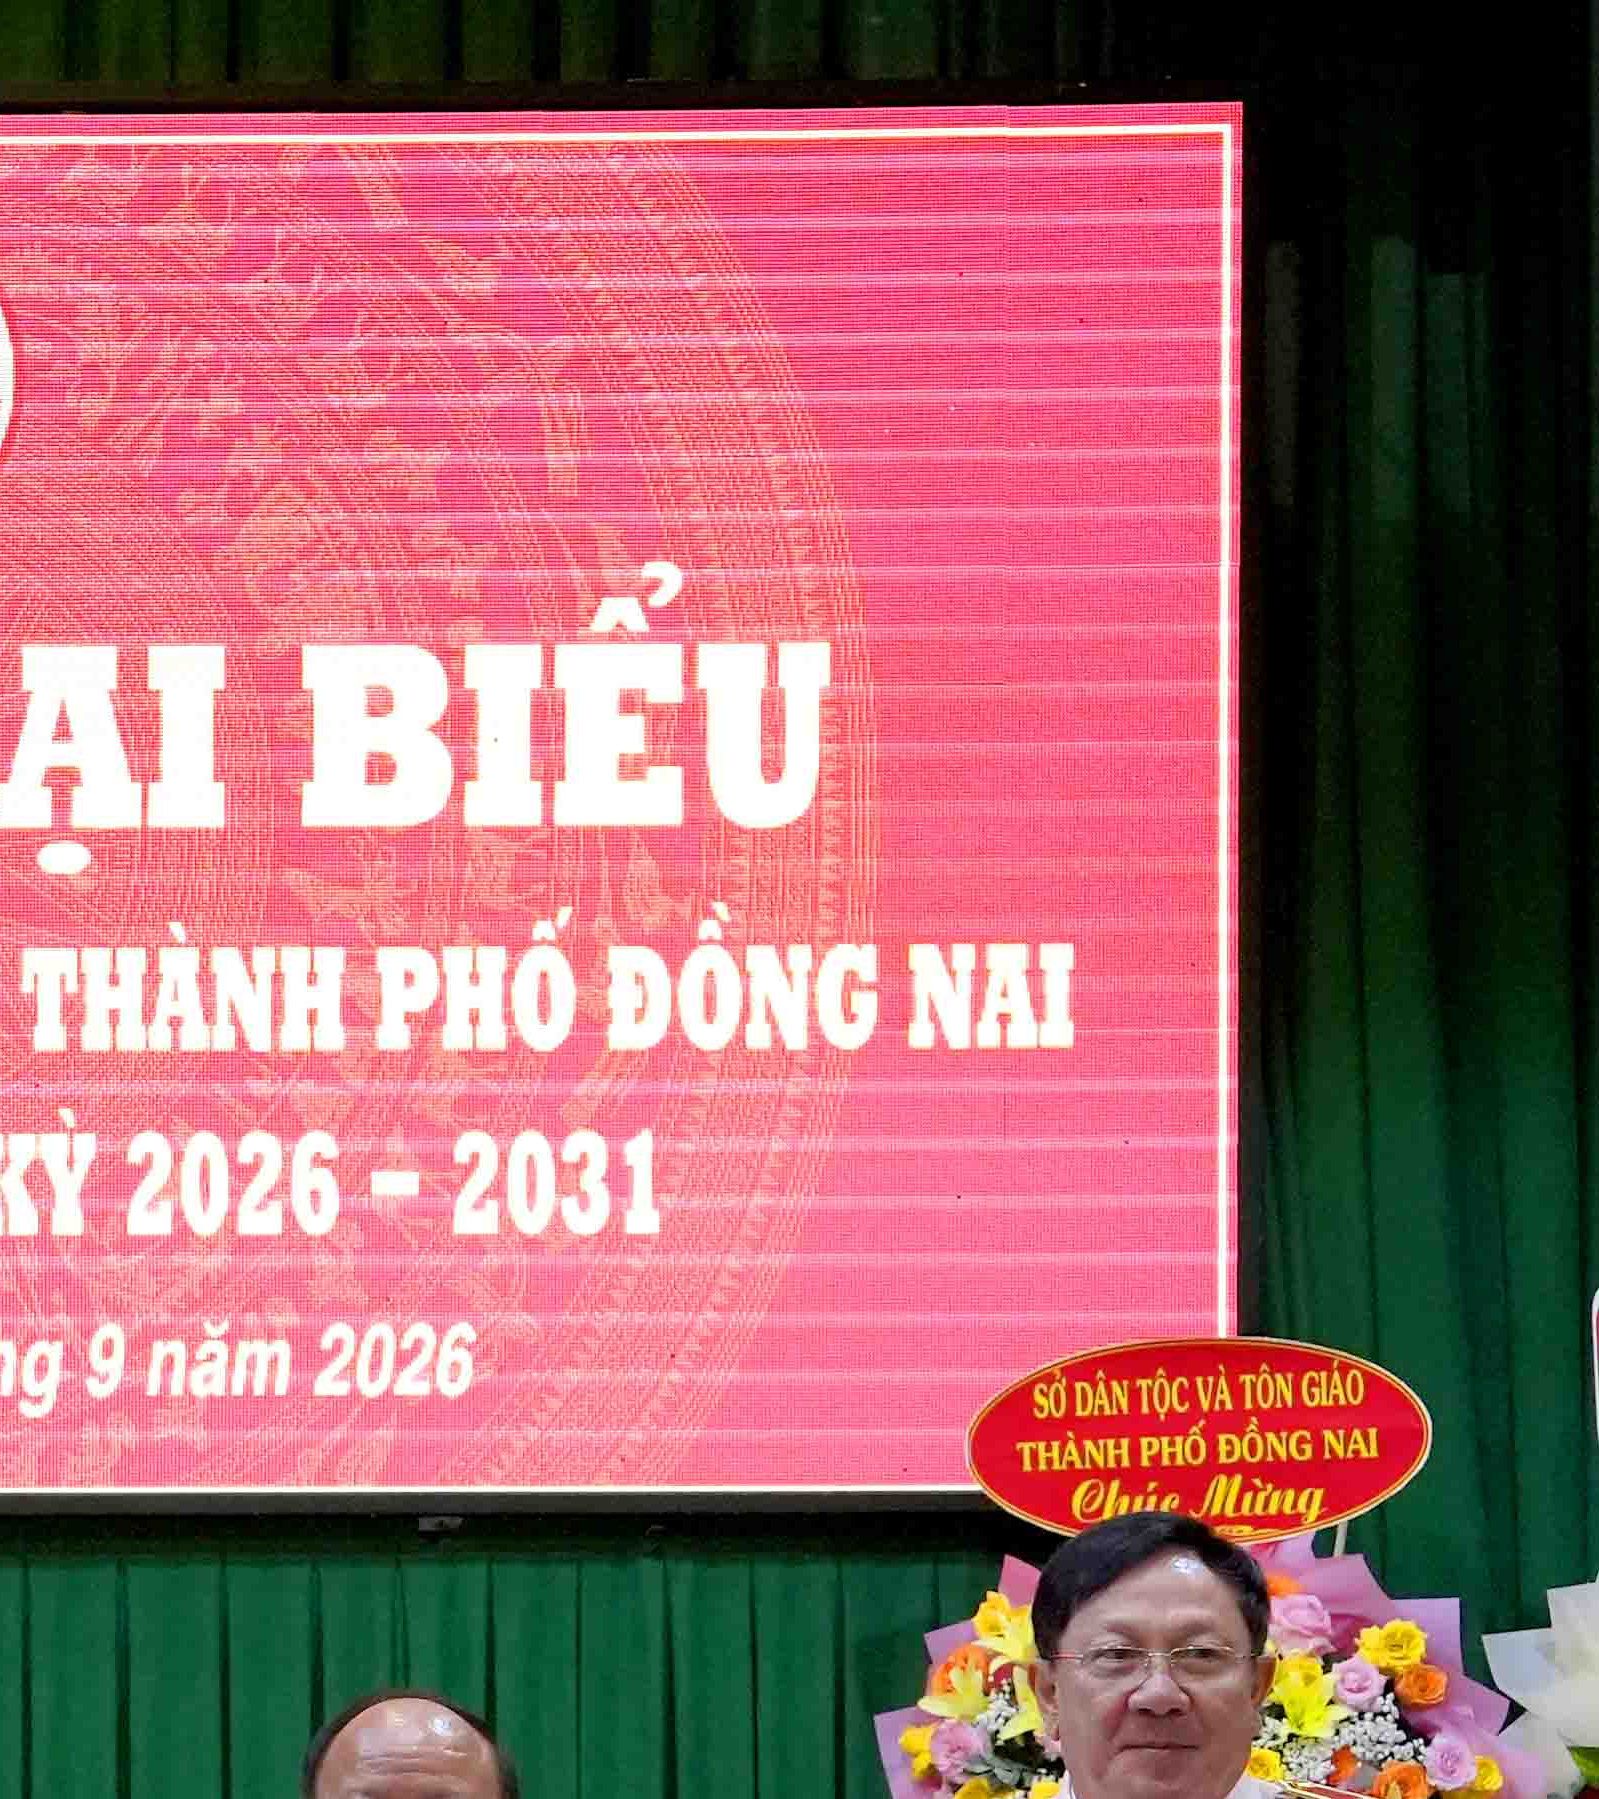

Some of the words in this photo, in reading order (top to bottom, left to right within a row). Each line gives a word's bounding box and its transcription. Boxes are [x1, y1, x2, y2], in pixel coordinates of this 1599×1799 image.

[302, 562, 830, 827] BIỂU
[20, 921, 347, 1052] THÀNH
[375, 906, 577, 1051] PHỐ
[607, 902, 878, 1051] ĐỒNG
[908, 943, 1074, 1049] NAI
[127, 1129, 340, 1236] 2026
[370, 1171, 420, 1197] -
[453, 1128, 660, 1236] 2031
[85, 1321, 125, 1399] 9
[146, 1317, 291, 1398] năm
[314, 1321, 477, 1398] 2026
[1033, 1368, 1066, 1419] SỞ
[1074, 1370, 1129, 1417] DÂN
[1136, 1367, 1190, 1421] TỘC
[1195, 1363, 1233, 1412] VÀ
[1239, 1362, 1293, 1410] TÔN
[1301, 1360, 1365, 1408] GIÁO
[1016, 1430, 1130, 1472] THÀNH
[1139, 1420, 1207, 1467] PHỐ
[1218, 1416, 1313, 1464] ĐỒNG
[1322, 1427, 1379, 1459] NAI
[1189, 1473, 1327, 1524] Mừng
